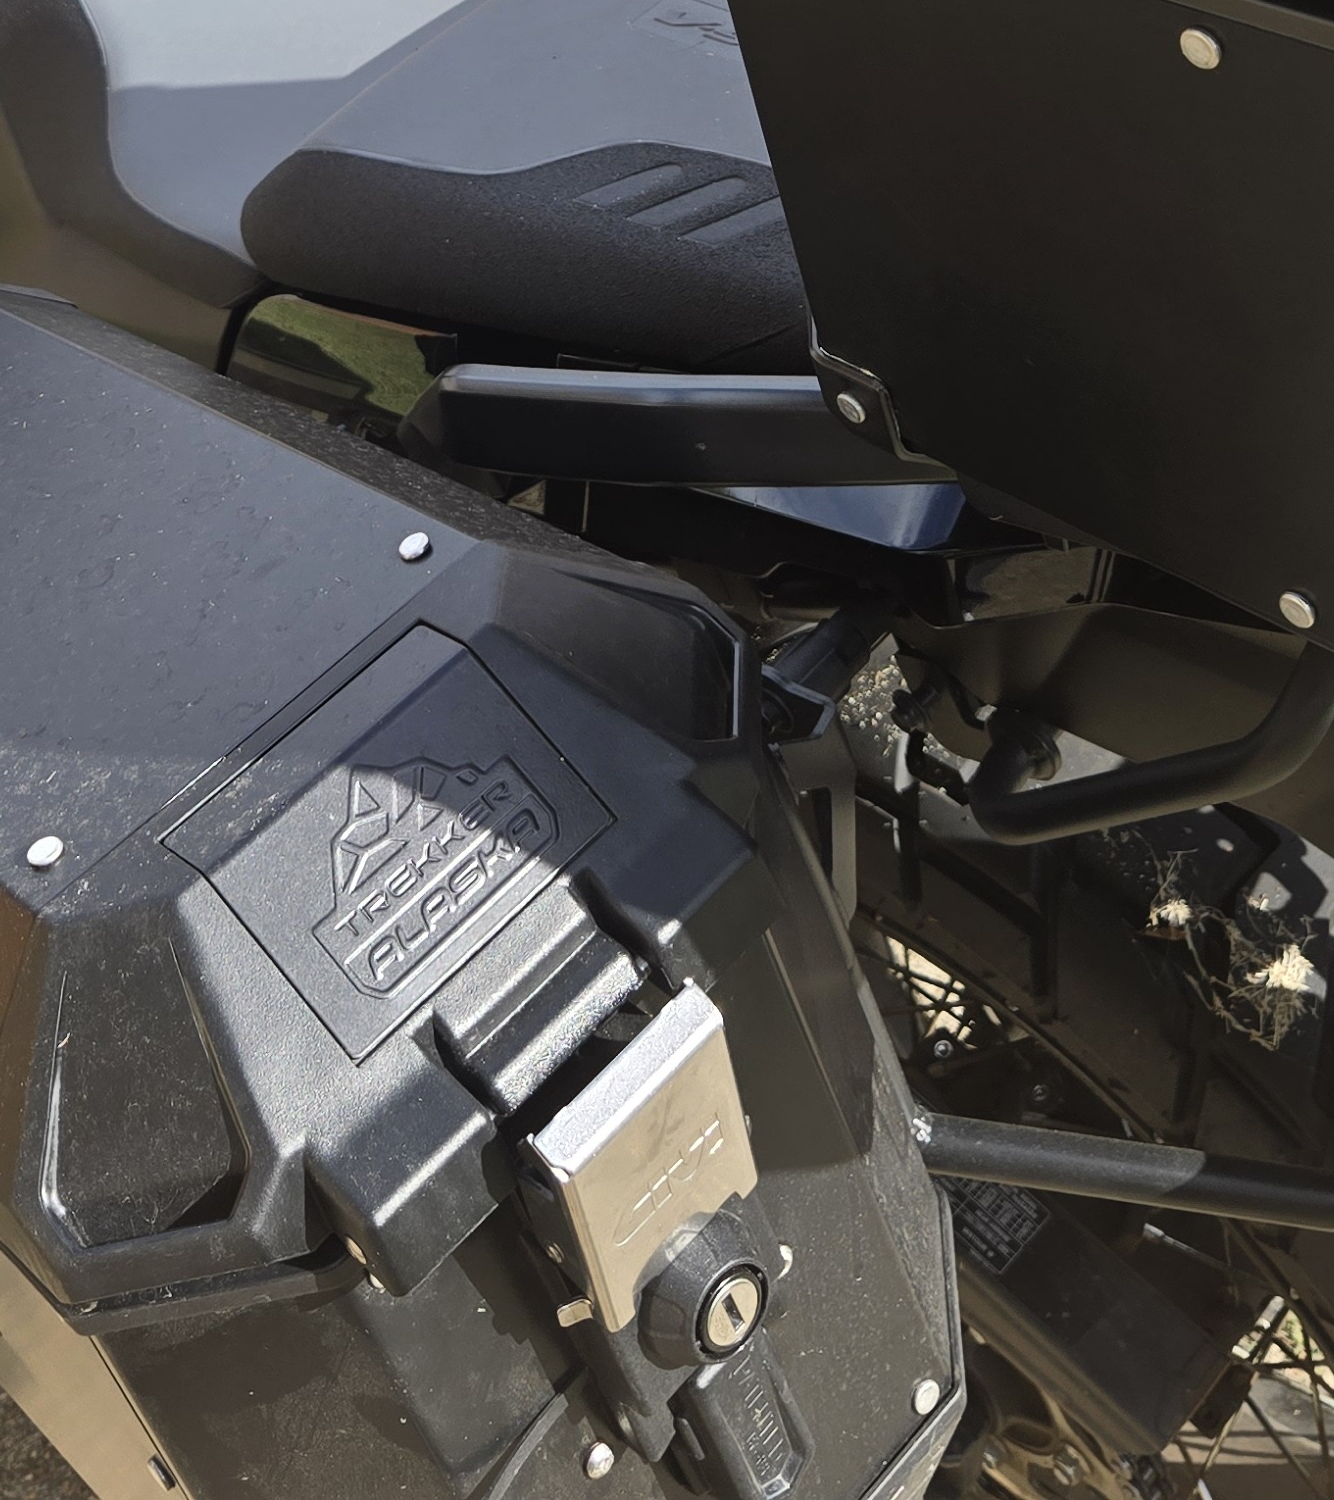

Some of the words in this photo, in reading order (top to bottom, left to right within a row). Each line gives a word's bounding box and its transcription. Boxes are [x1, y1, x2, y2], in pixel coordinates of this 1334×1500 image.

[335, 779, 511, 937] TREKKER
[367, 806, 541, 981] ALASKA
[615, 1113, 724, 1248] GIVI
